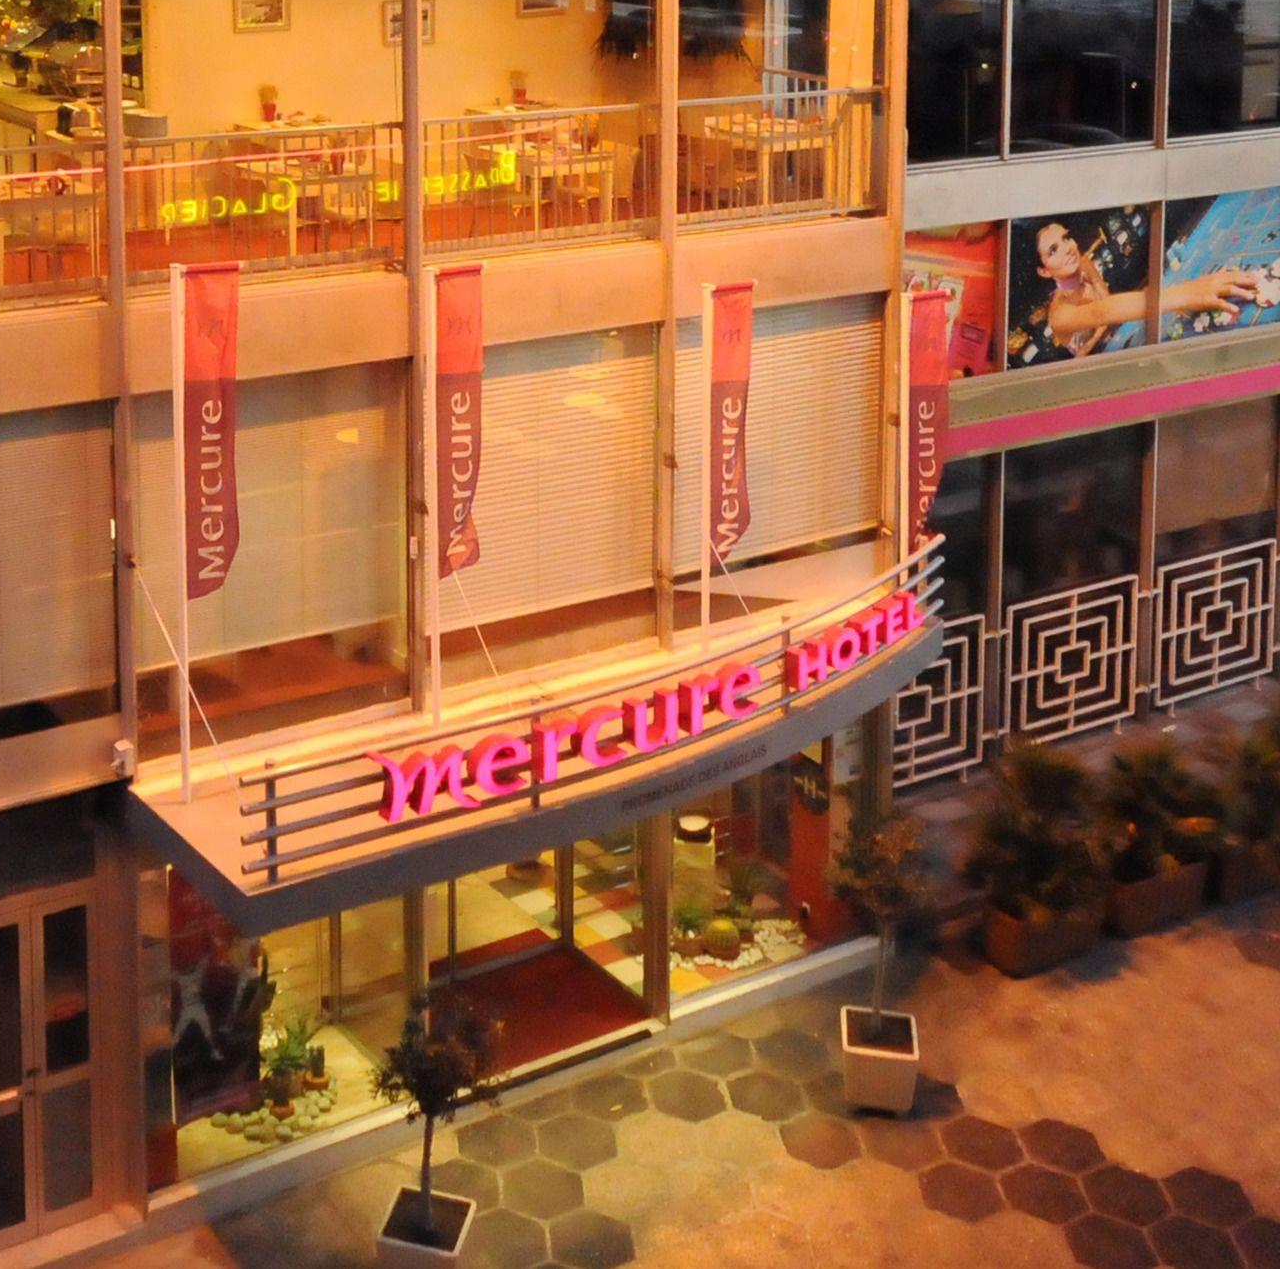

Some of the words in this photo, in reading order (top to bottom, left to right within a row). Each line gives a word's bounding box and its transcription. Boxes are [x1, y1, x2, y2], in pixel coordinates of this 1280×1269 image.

[198, 399, 225, 581] Mercure
[717, 397, 742, 553] Mercure
[786, 589, 926, 692] HOTEL
[723, 744, 768, 772] ANGLAIS
